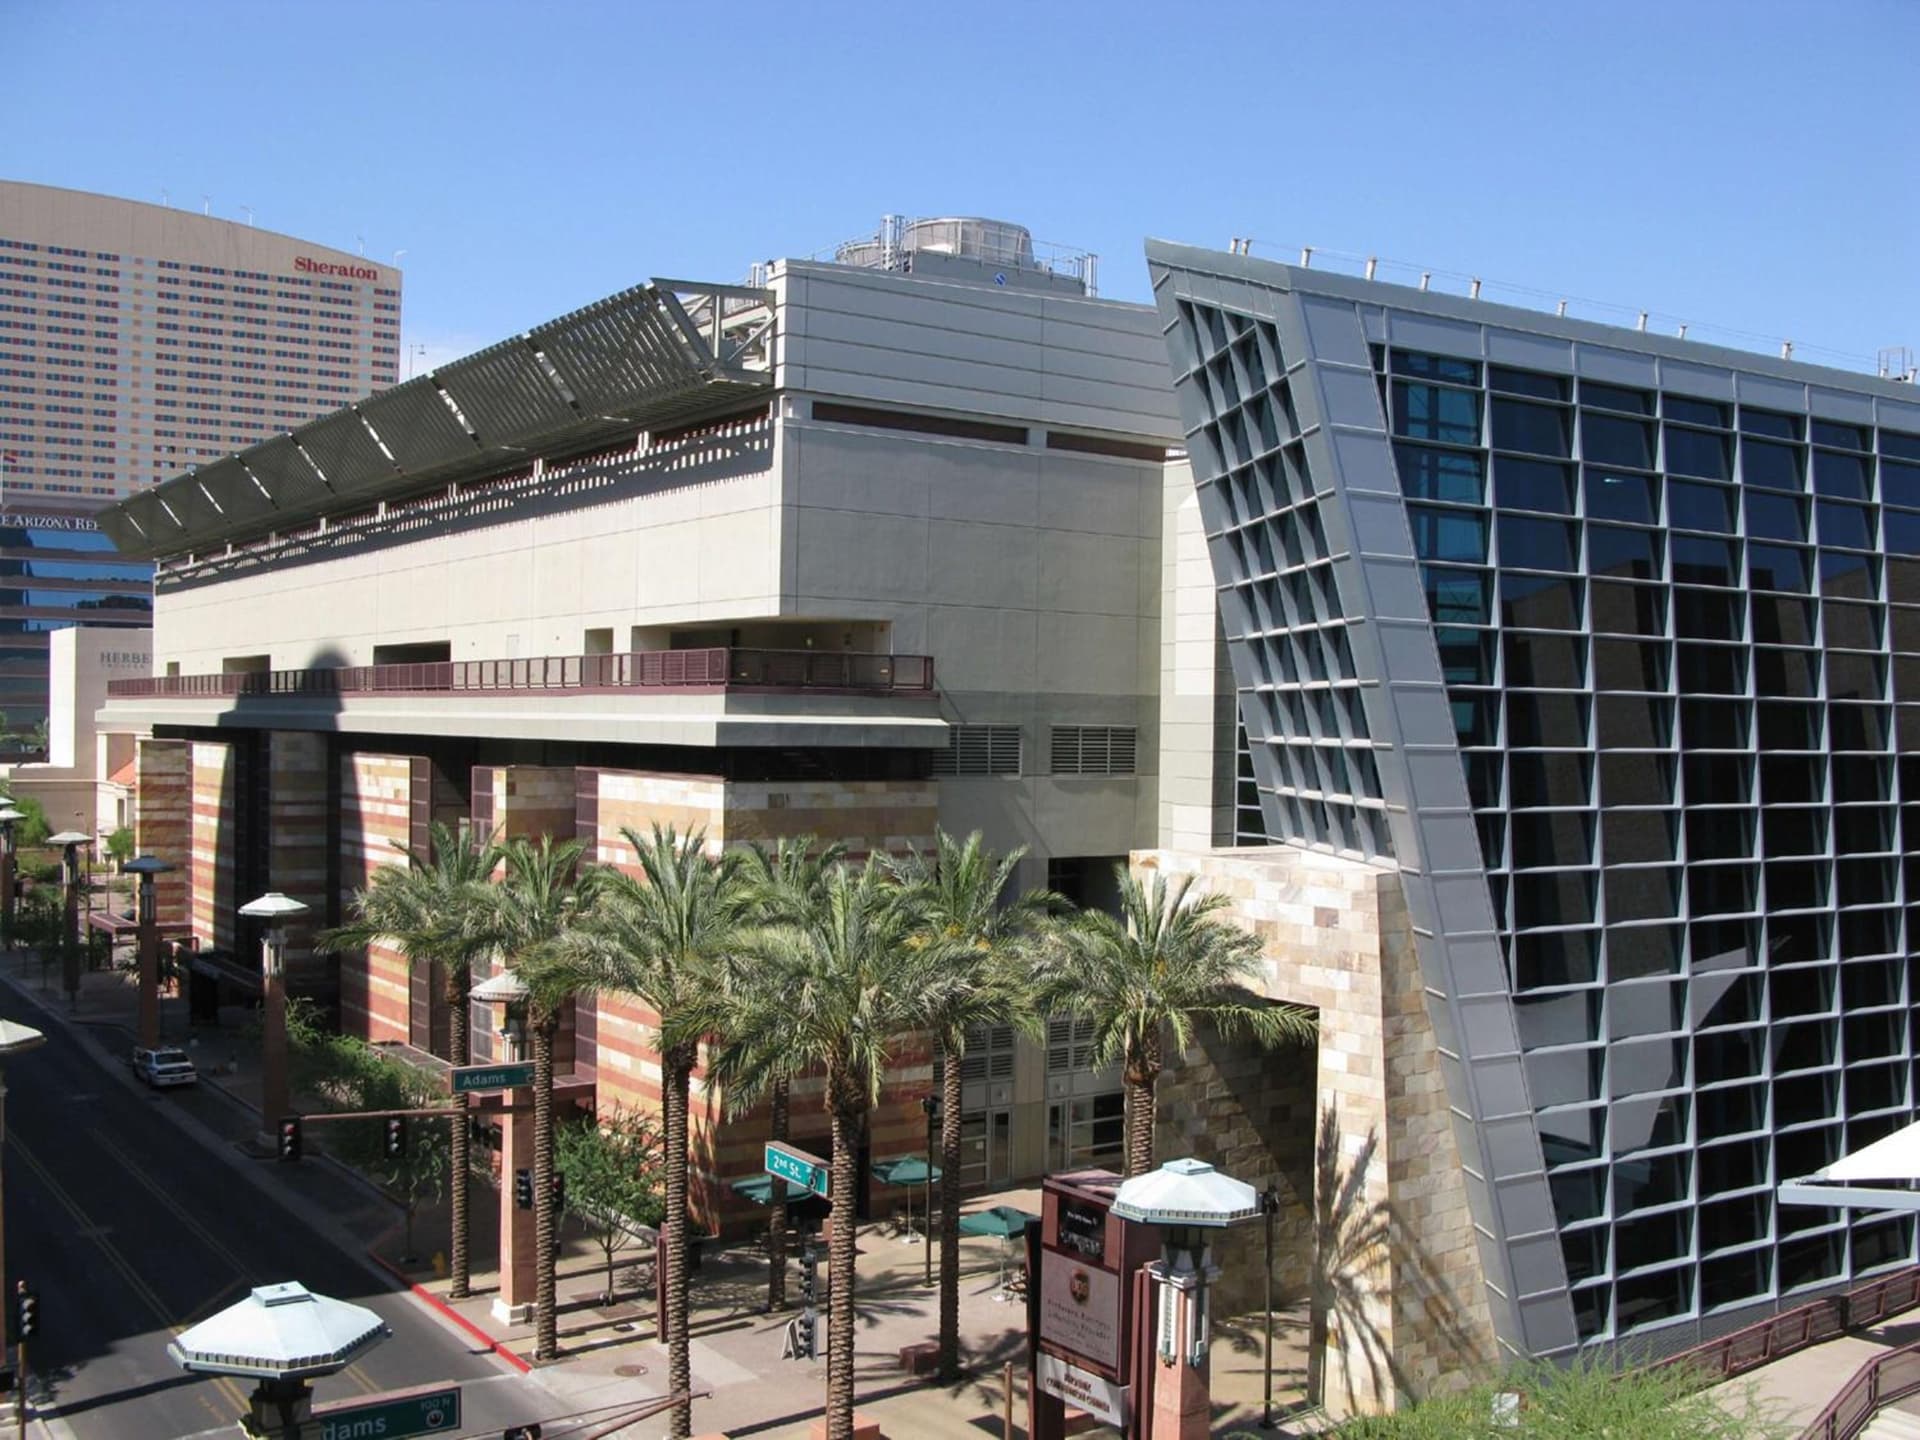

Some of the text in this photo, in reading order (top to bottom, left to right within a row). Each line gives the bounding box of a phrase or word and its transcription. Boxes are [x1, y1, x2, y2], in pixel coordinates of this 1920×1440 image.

[294, 256, 377, 281] Sheraton
[100, 652, 153, 664] HERBE
[463, 1073, 507, 1088] Adams
[322, 1417, 387, 1440] dams
